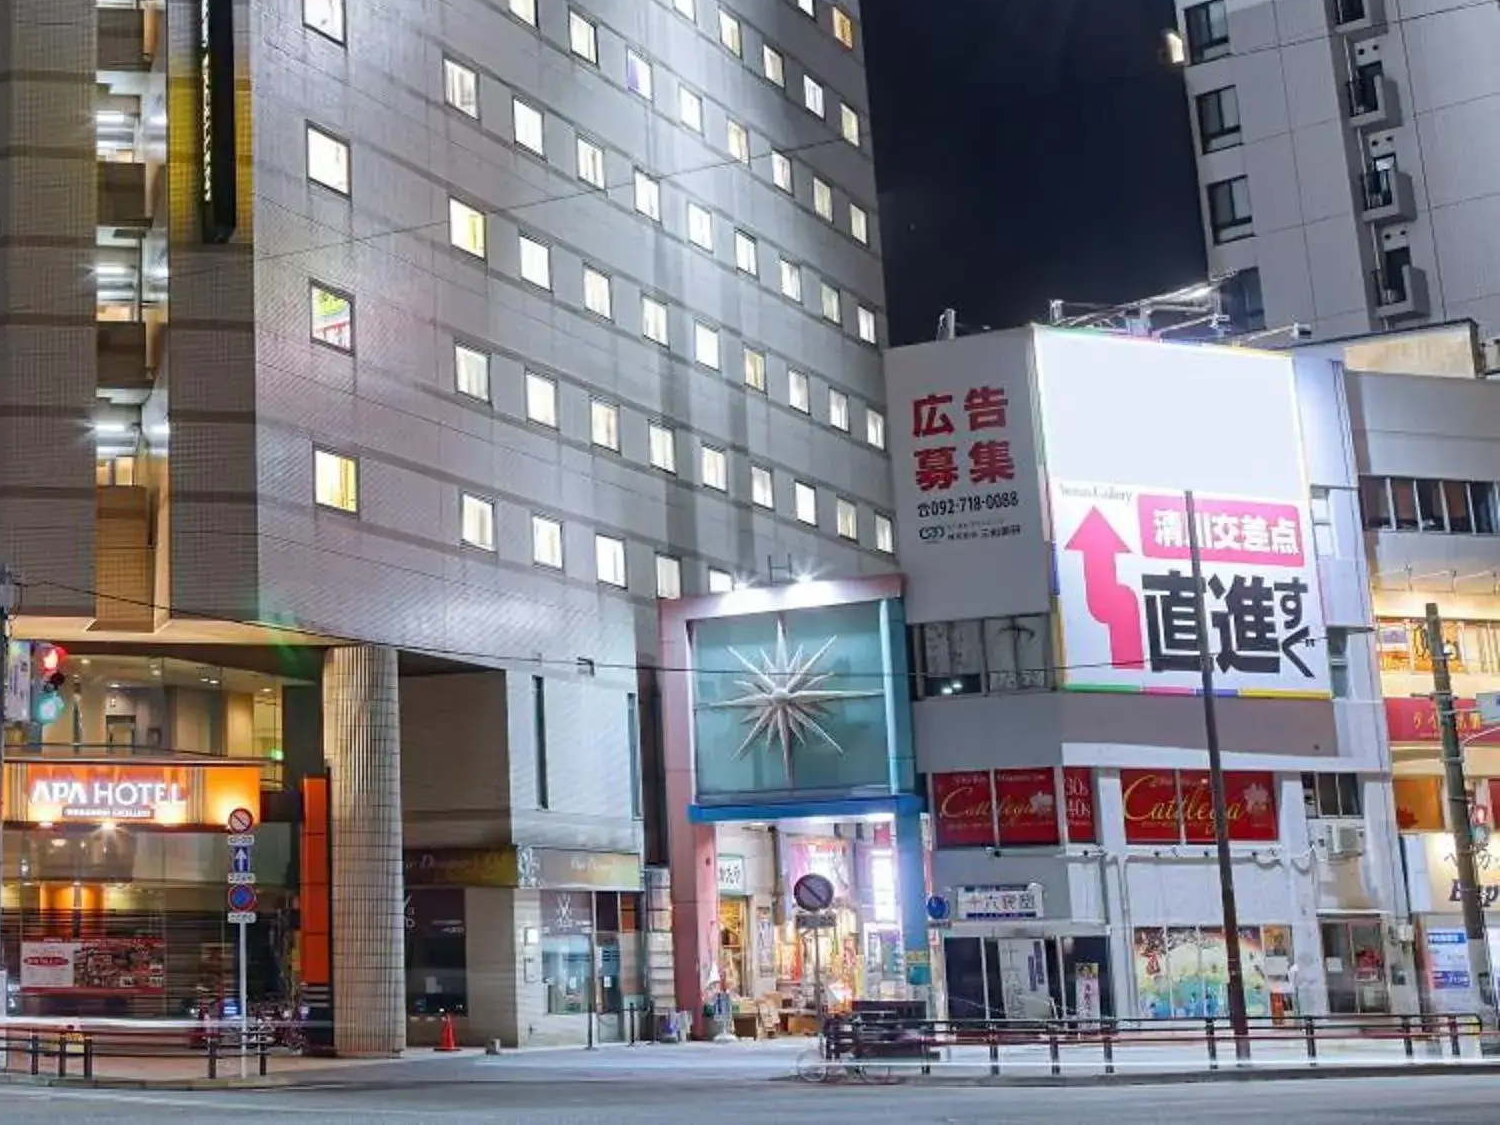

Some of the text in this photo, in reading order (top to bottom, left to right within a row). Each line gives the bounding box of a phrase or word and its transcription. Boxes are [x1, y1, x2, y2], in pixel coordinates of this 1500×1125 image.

[913, 385, 1008, 437] 広告
[914, 440, 1015, 491] 募集
[1141, 569, 1316, 678] 直進 すぐ
[32, 780, 187, 806] APA HOTEL
